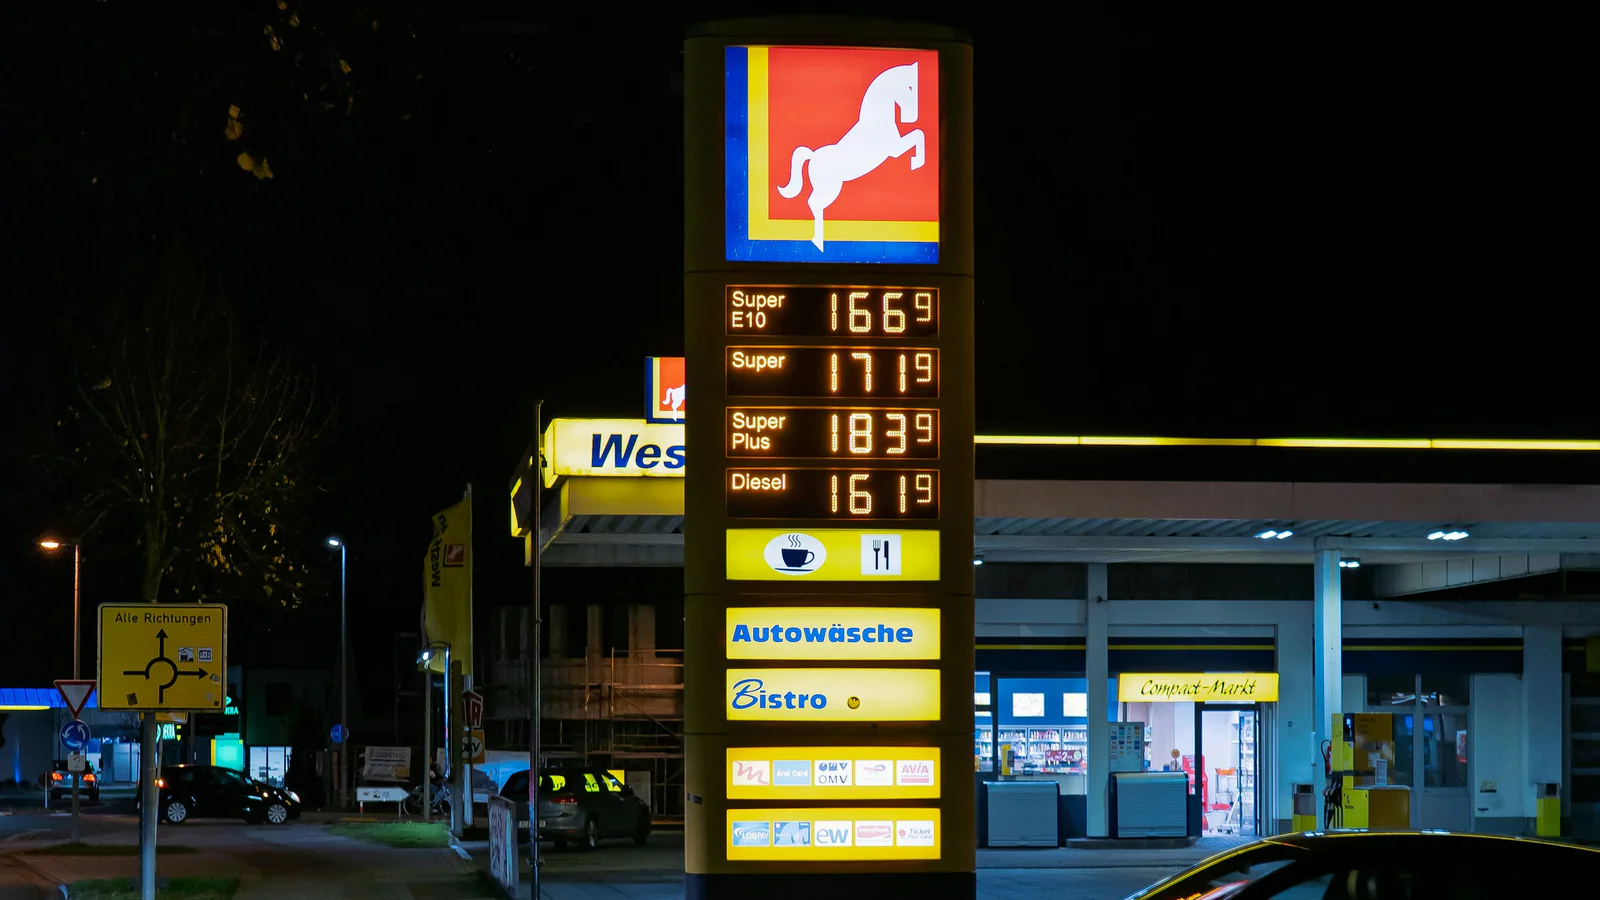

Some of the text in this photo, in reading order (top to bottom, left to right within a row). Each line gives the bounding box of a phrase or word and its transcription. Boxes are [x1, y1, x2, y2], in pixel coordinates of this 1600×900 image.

[732, 291, 785, 311] Super
[732, 311, 767, 328] E10
[732, 352, 785, 372] Super
[732, 412, 786, 432] Super
[732, 433, 770, 450] Plus
[732, 473, 786, 490] Diesel
[115, 612, 211, 626] Alle Richtungen
[732, 624, 914, 643] Autowäsche
[731, 678, 827, 710] Bistro
[1140, 679, 1257, 700] Compact-Markt
[224, 706, 239, 715] KRA
[818, 774, 848, 784] OMV
